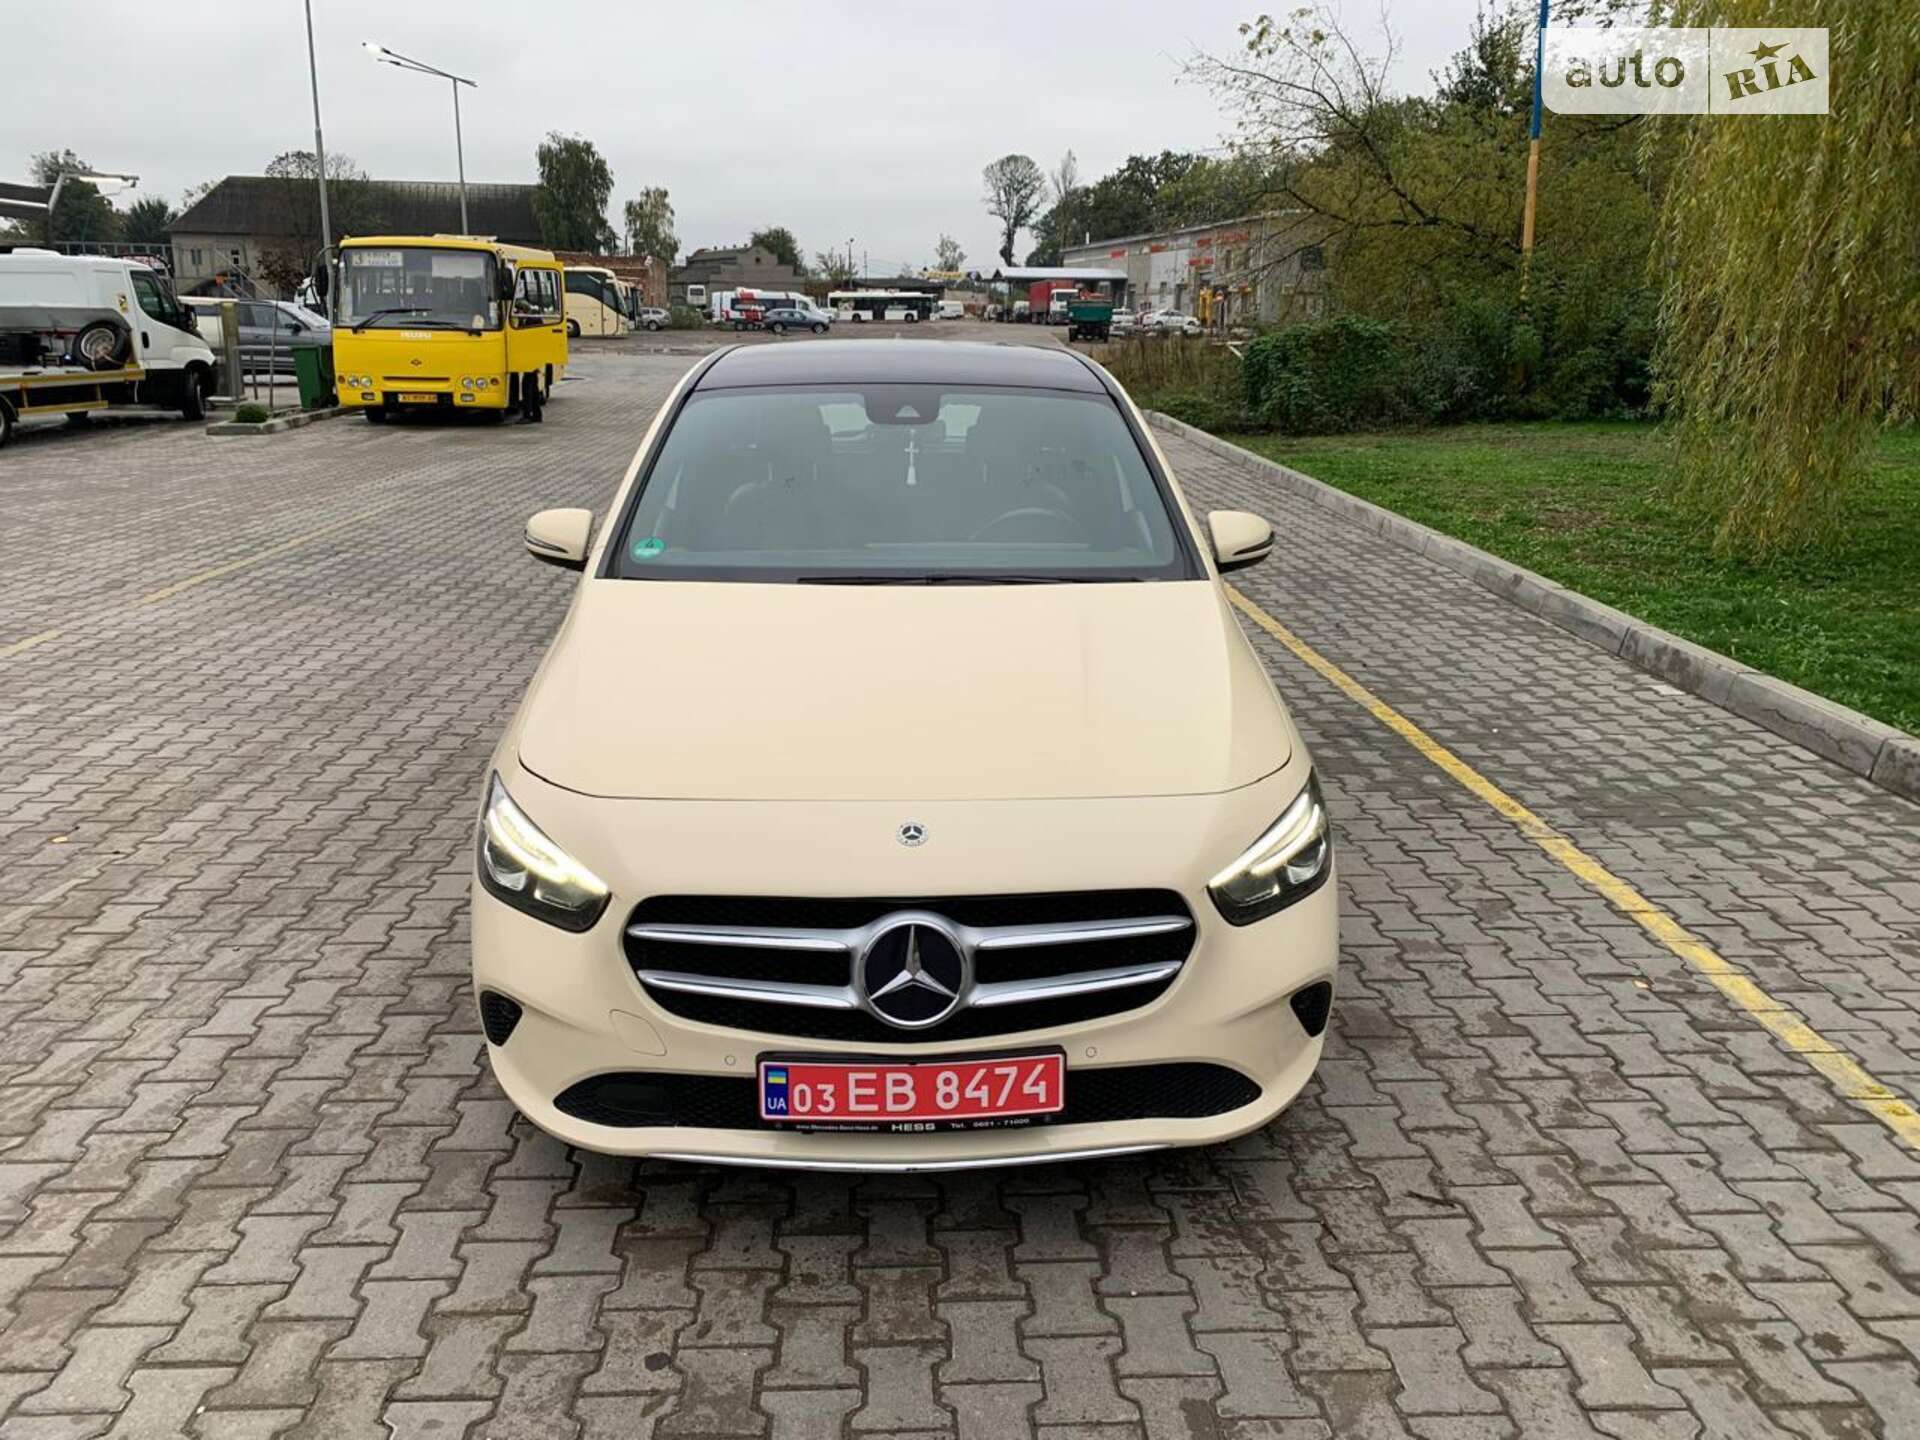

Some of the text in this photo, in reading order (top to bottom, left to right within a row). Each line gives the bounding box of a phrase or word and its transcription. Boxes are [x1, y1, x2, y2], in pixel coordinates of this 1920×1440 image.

[793, 1062, 1047, 1113] 03 EB 8474
[768, 1097, 787, 1110] UA
[891, 1122, 936, 1132] HESS
